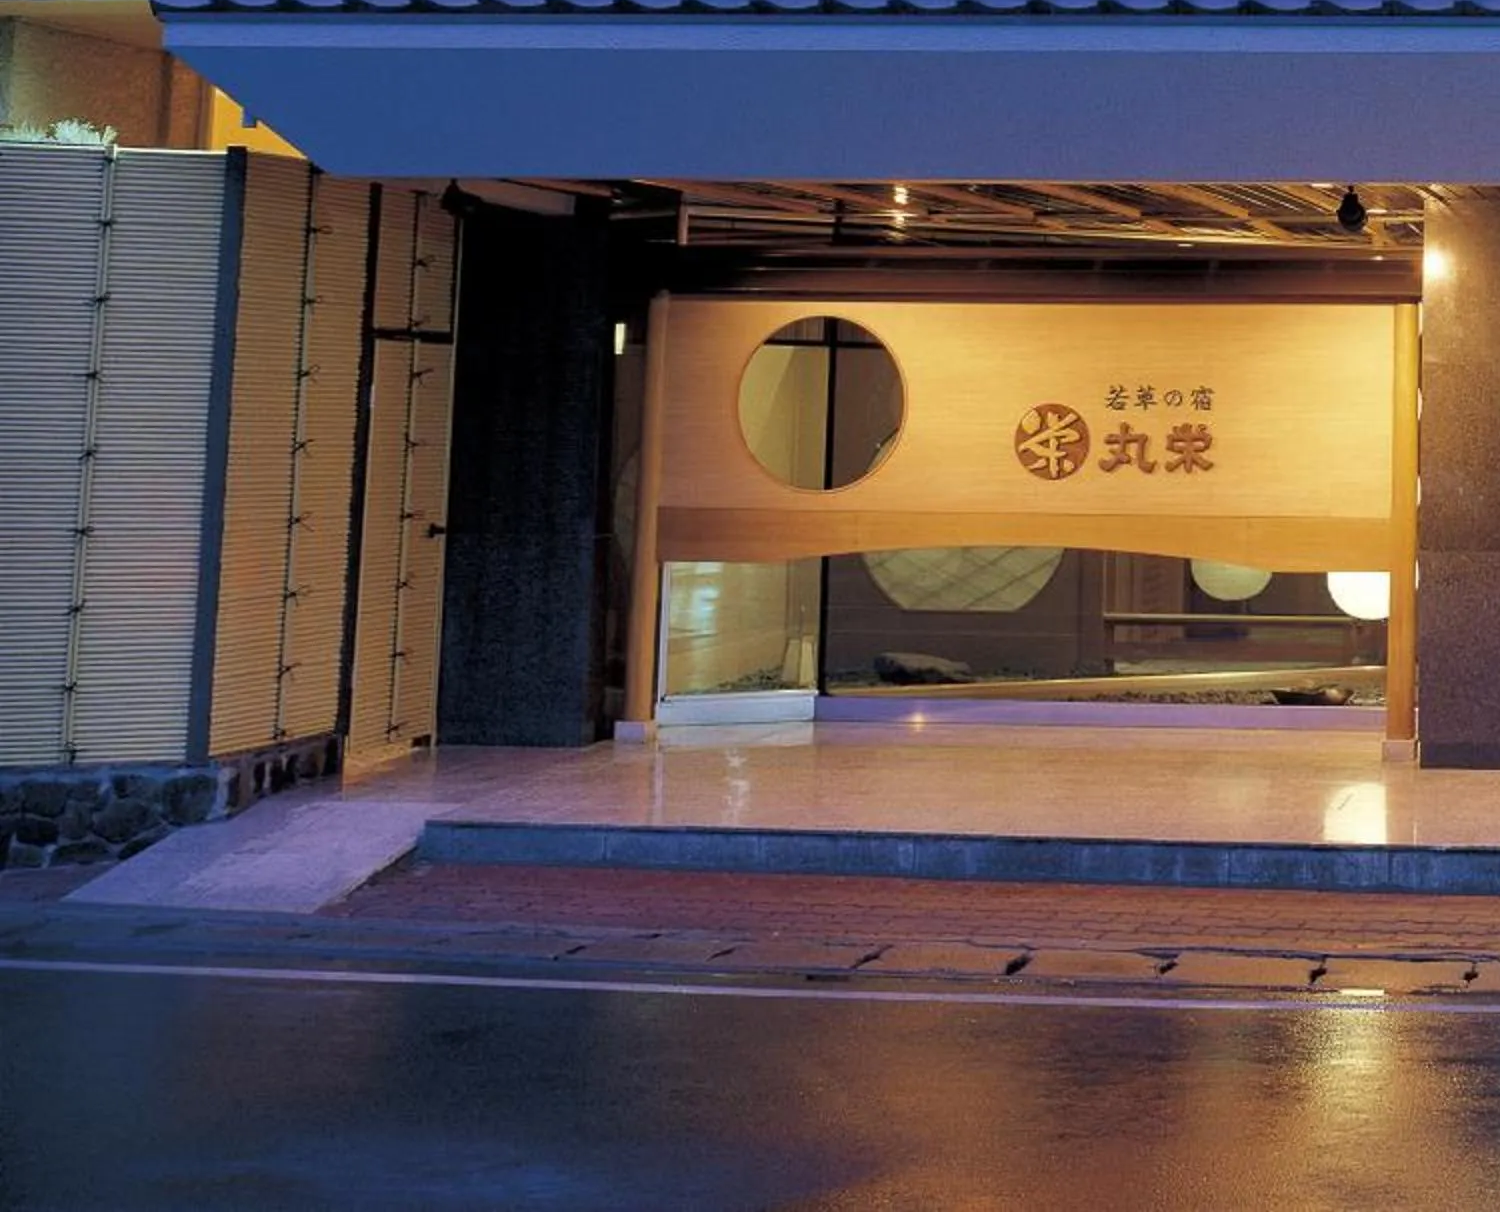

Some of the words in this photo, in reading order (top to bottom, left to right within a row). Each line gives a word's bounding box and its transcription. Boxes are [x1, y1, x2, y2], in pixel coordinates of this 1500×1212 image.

[1104, 385, 1215, 410] 若草の宿
[1098, 422, 1215, 474] 丸栄
